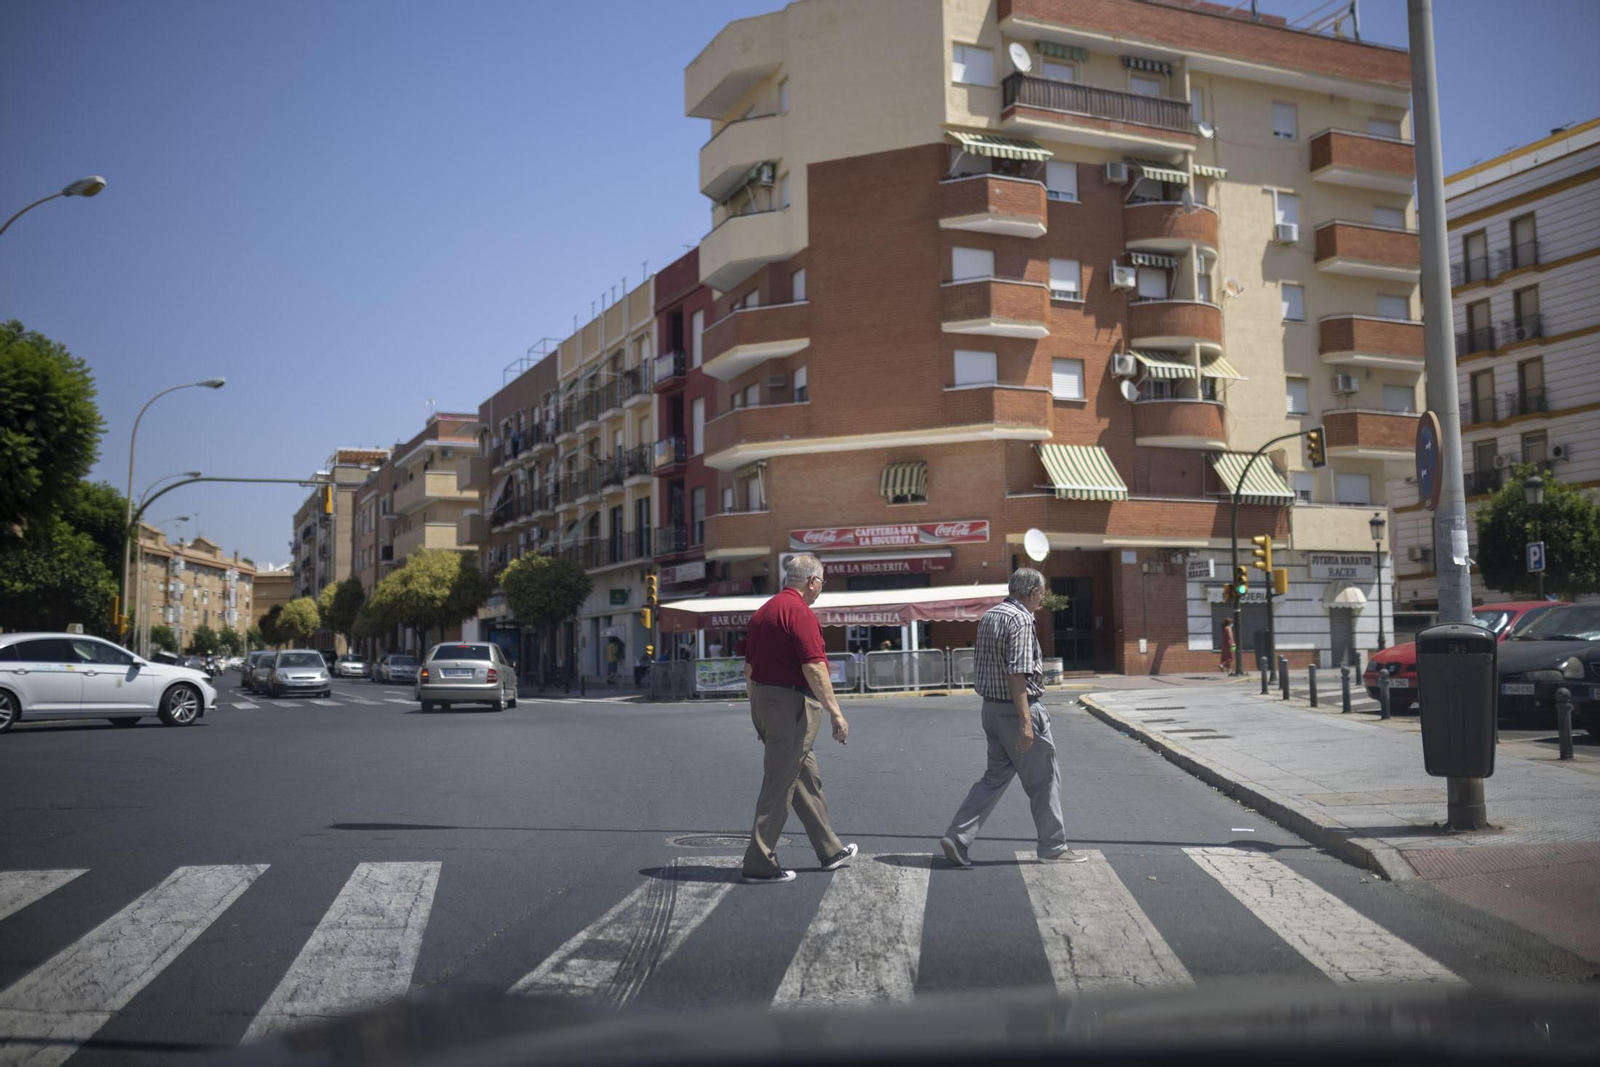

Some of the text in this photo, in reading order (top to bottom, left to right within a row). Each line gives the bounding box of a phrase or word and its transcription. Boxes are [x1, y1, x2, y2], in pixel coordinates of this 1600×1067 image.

[934, 523, 971, 536] Coca-Cola
[803, 530, 837, 543] Coca-Cola
[859, 535, 916, 545] LA HIGUERITA
[1340, 556, 1372, 565] MARAVER
[1530, 546, 1540, 569] P
[827, 565, 846, 574] BAR
[847, 564, 860, 573] LA
[861, 562, 910, 572] HIGUERITA
[711, 615, 730, 626] BAR
[826, 612, 841, 622] LA
[843, 612, 901, 622] HIGUERITA
